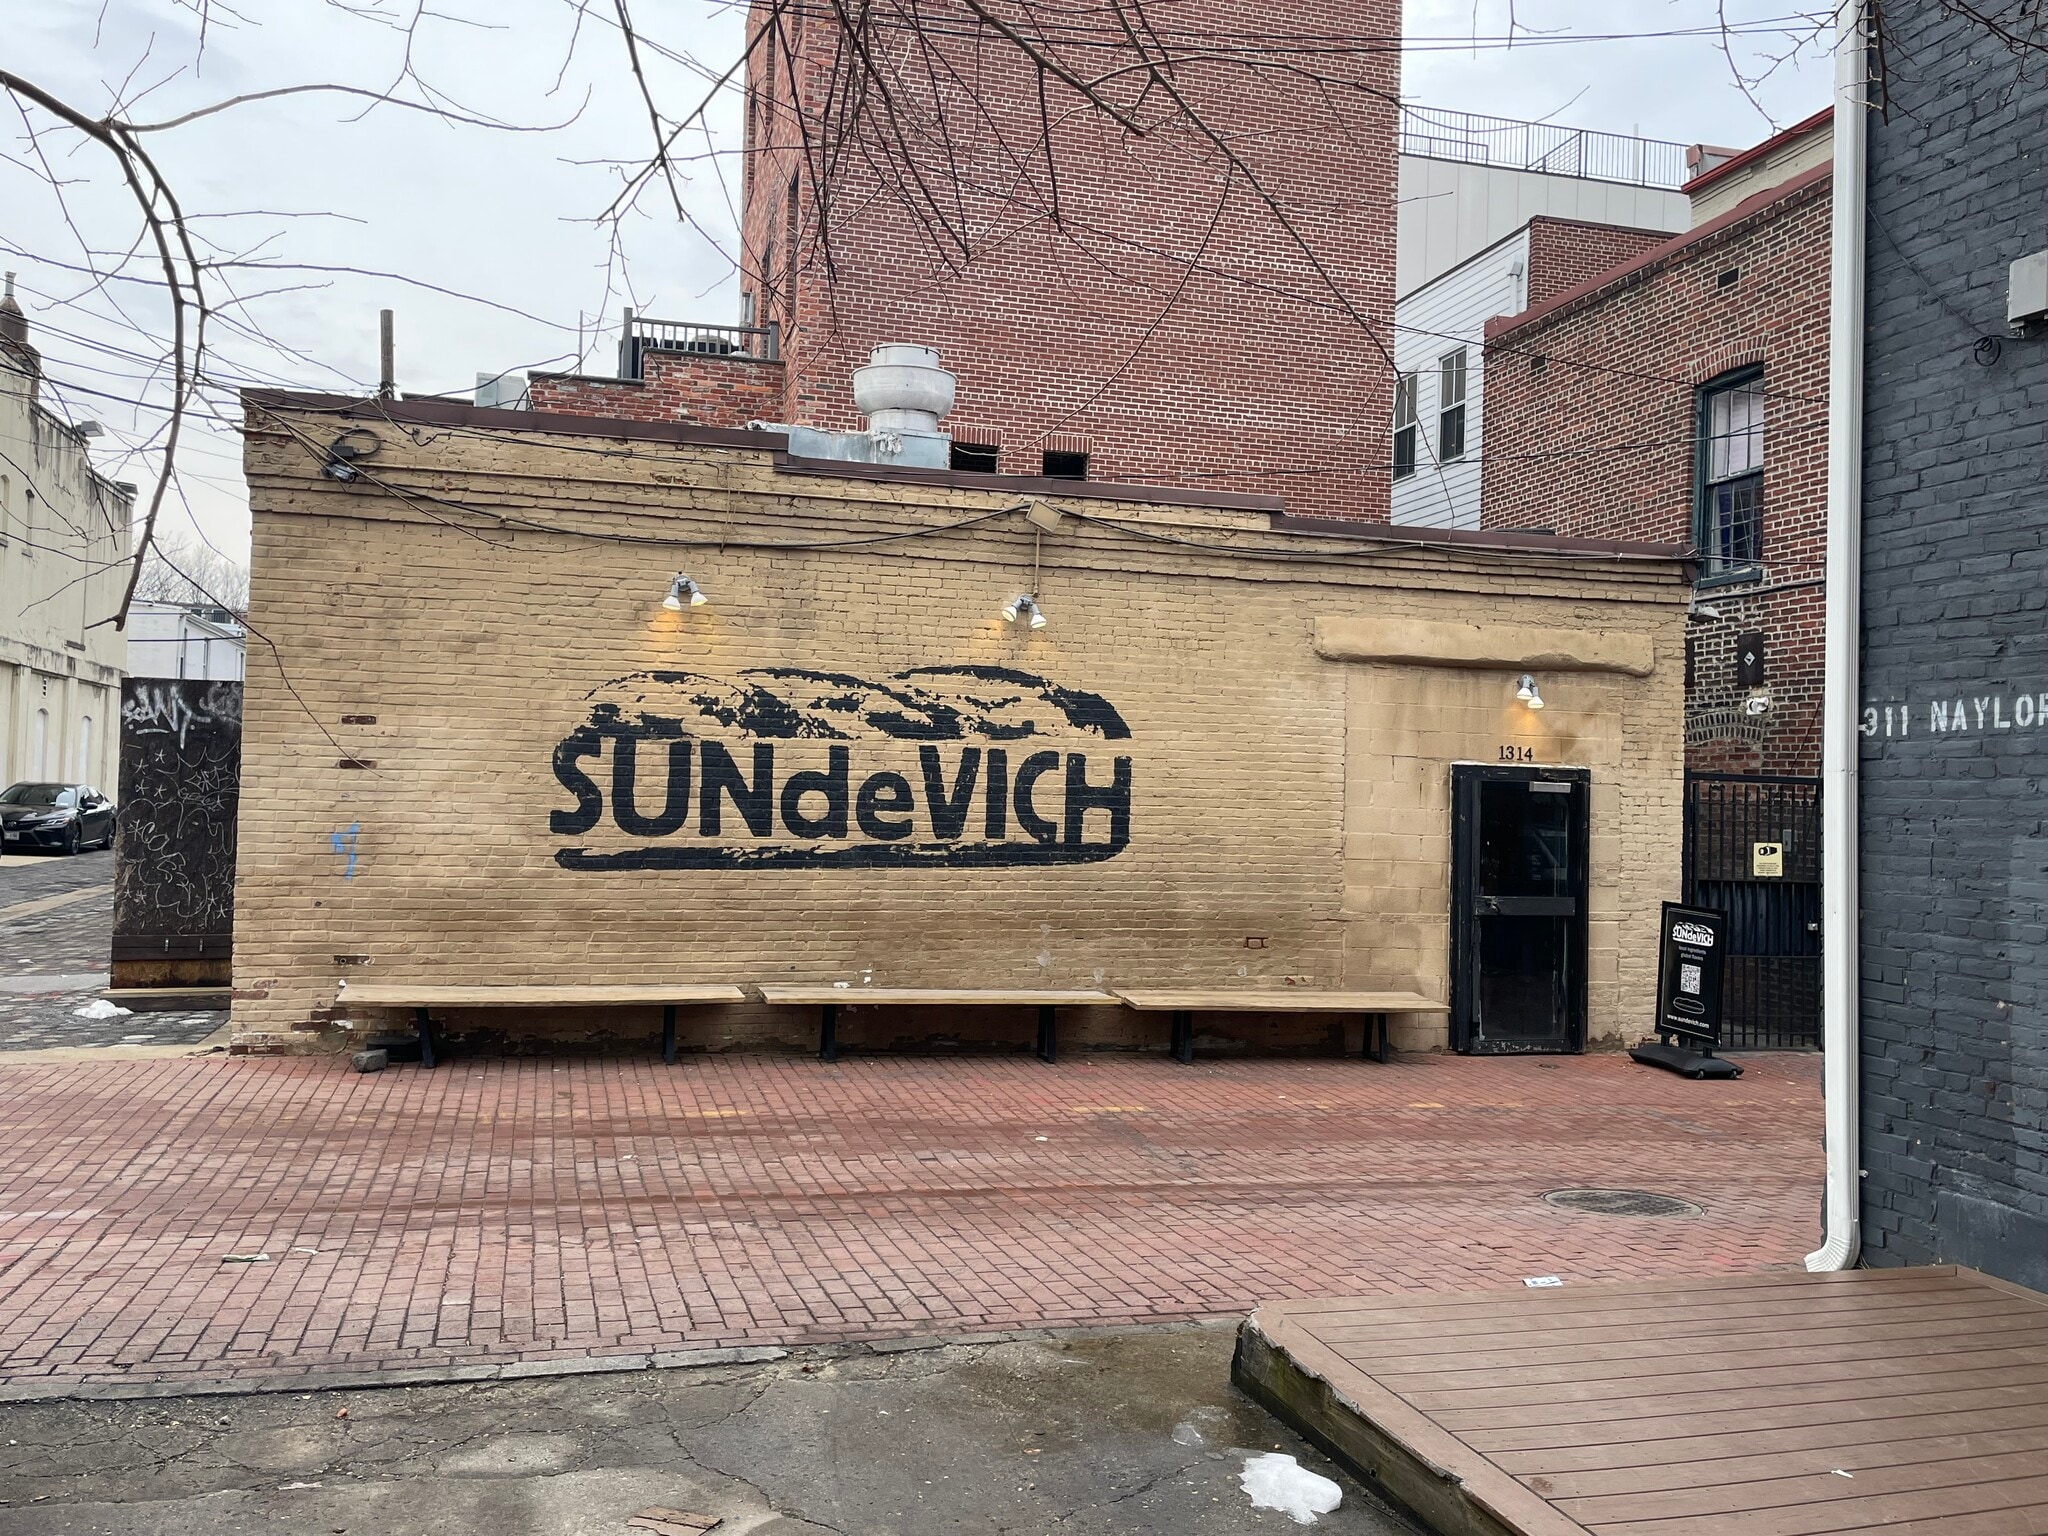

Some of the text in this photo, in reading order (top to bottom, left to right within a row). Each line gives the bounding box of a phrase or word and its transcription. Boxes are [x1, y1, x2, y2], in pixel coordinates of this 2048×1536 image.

[1498, 745, 1534, 762] 1314
[550, 735, 1132, 847] SUNdeVICH
[1666, 1014, 1710, 1029] www.sundevich.com
